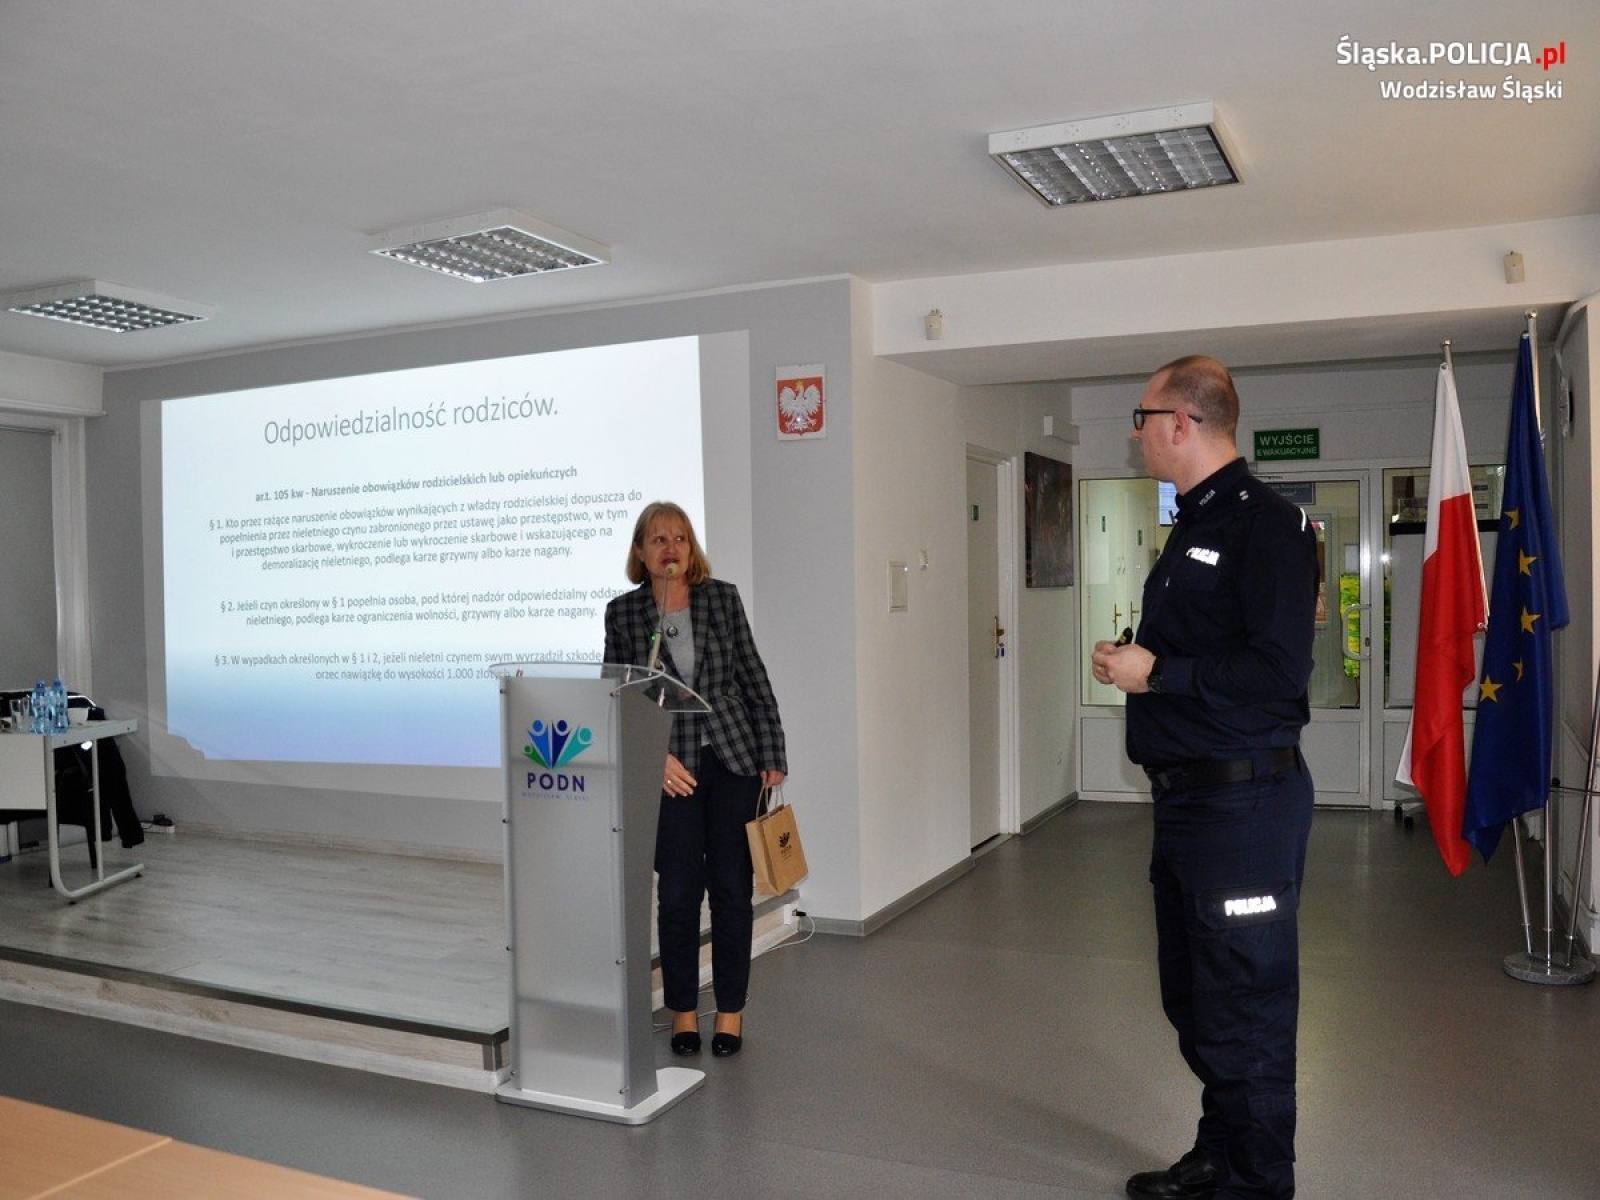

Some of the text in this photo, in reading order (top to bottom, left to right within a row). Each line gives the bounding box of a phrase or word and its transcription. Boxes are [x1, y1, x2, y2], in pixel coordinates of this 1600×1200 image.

[264, 392, 558, 446] Odpowiedzialność rodziców.
[1257, 446, 1317, 456] EWAKUACYJNE
[1260, 432, 1314, 446] WYJŚCIE
[274, 489, 288, 500] 105
[292, 488, 303, 498] kw
[312, 484, 360, 497] Naruszenie
[362, 479, 420, 494] obowiązków
[422, 473, 486, 488] rodzicielskich
[489, 472, 504, 483] lub
[508, 466, 577, 483] opiekuńczych
[209, 490, 642, 530] § 1. Kto przez rażące naruszenie obowiązków wynikających z władzy rodzicielskiej dopuszcza do
[220, 509, 628, 545] popełnienia przez nieletniego czynu zabronionego przez ustawę jako przestępstwo, w tym
[236, 545, 289, 559] przestępstwo
[292, 542, 335, 555] skarbowe,
[337, 538, 391, 551] wykroczenie
[394, 536, 408, 548] lub
[410, 533, 468, 547] wykroczenie
[471, 530, 517, 544] skarbowe
[526, 526, 596, 541] wskazującego
[600, 527, 612, 536] na
[262, 545, 572, 571] demoralizację nieletniego, podlega karze grzywny albo karze nagany.
[221, 601, 225, 613] §
[228, 601, 235, 611] 2.
[237, 599, 257, 611] Jeżeli
[260, 601, 278, 612] czyn
[280, 598, 320, 611] określony
[323, 599, 329, 607] w
[332, 596, 338, 609] §
[341, 597, 345, 607] 1
[348, 595, 386, 609] popełnia
[388, 594, 419, 606] osoba,
[421, 592, 439, 606] pod
[442, 592, 469, 605] której
[472, 589, 504, 602] nadzór
[508, 588, 588, 603] odpowiedzialny
[246, 606, 597, 627] nieletniego, podlega karze ograniczenia wolności, grzywny albo karze nagany.
[214, 655, 219, 666] §
[222, 655, 229, 664] 3.
[231, 655, 239, 664] W
[241, 654, 287, 667] wypadkach
[289, 653, 339, 665] określonych
[342, 655, 349, 663] w
[352, 653, 357, 664] §
[360, 653, 364, 663] 1
[373, 653, 380, 664] 2,
[383, 652, 406, 664] jeżeli
[409, 651, 443, 663] nieletni
[447, 652, 482, 664] czynem
[485, 652, 512, 663] swym
[316, 671, 339, 680] orzec
[341, 668, 381, 681] nawiązkę
[384, 669, 395, 679] do
[398, 667, 444, 681] wysokości
[447, 669, 473, 679] 1.000
[528, 772, 584, 792] PODN
